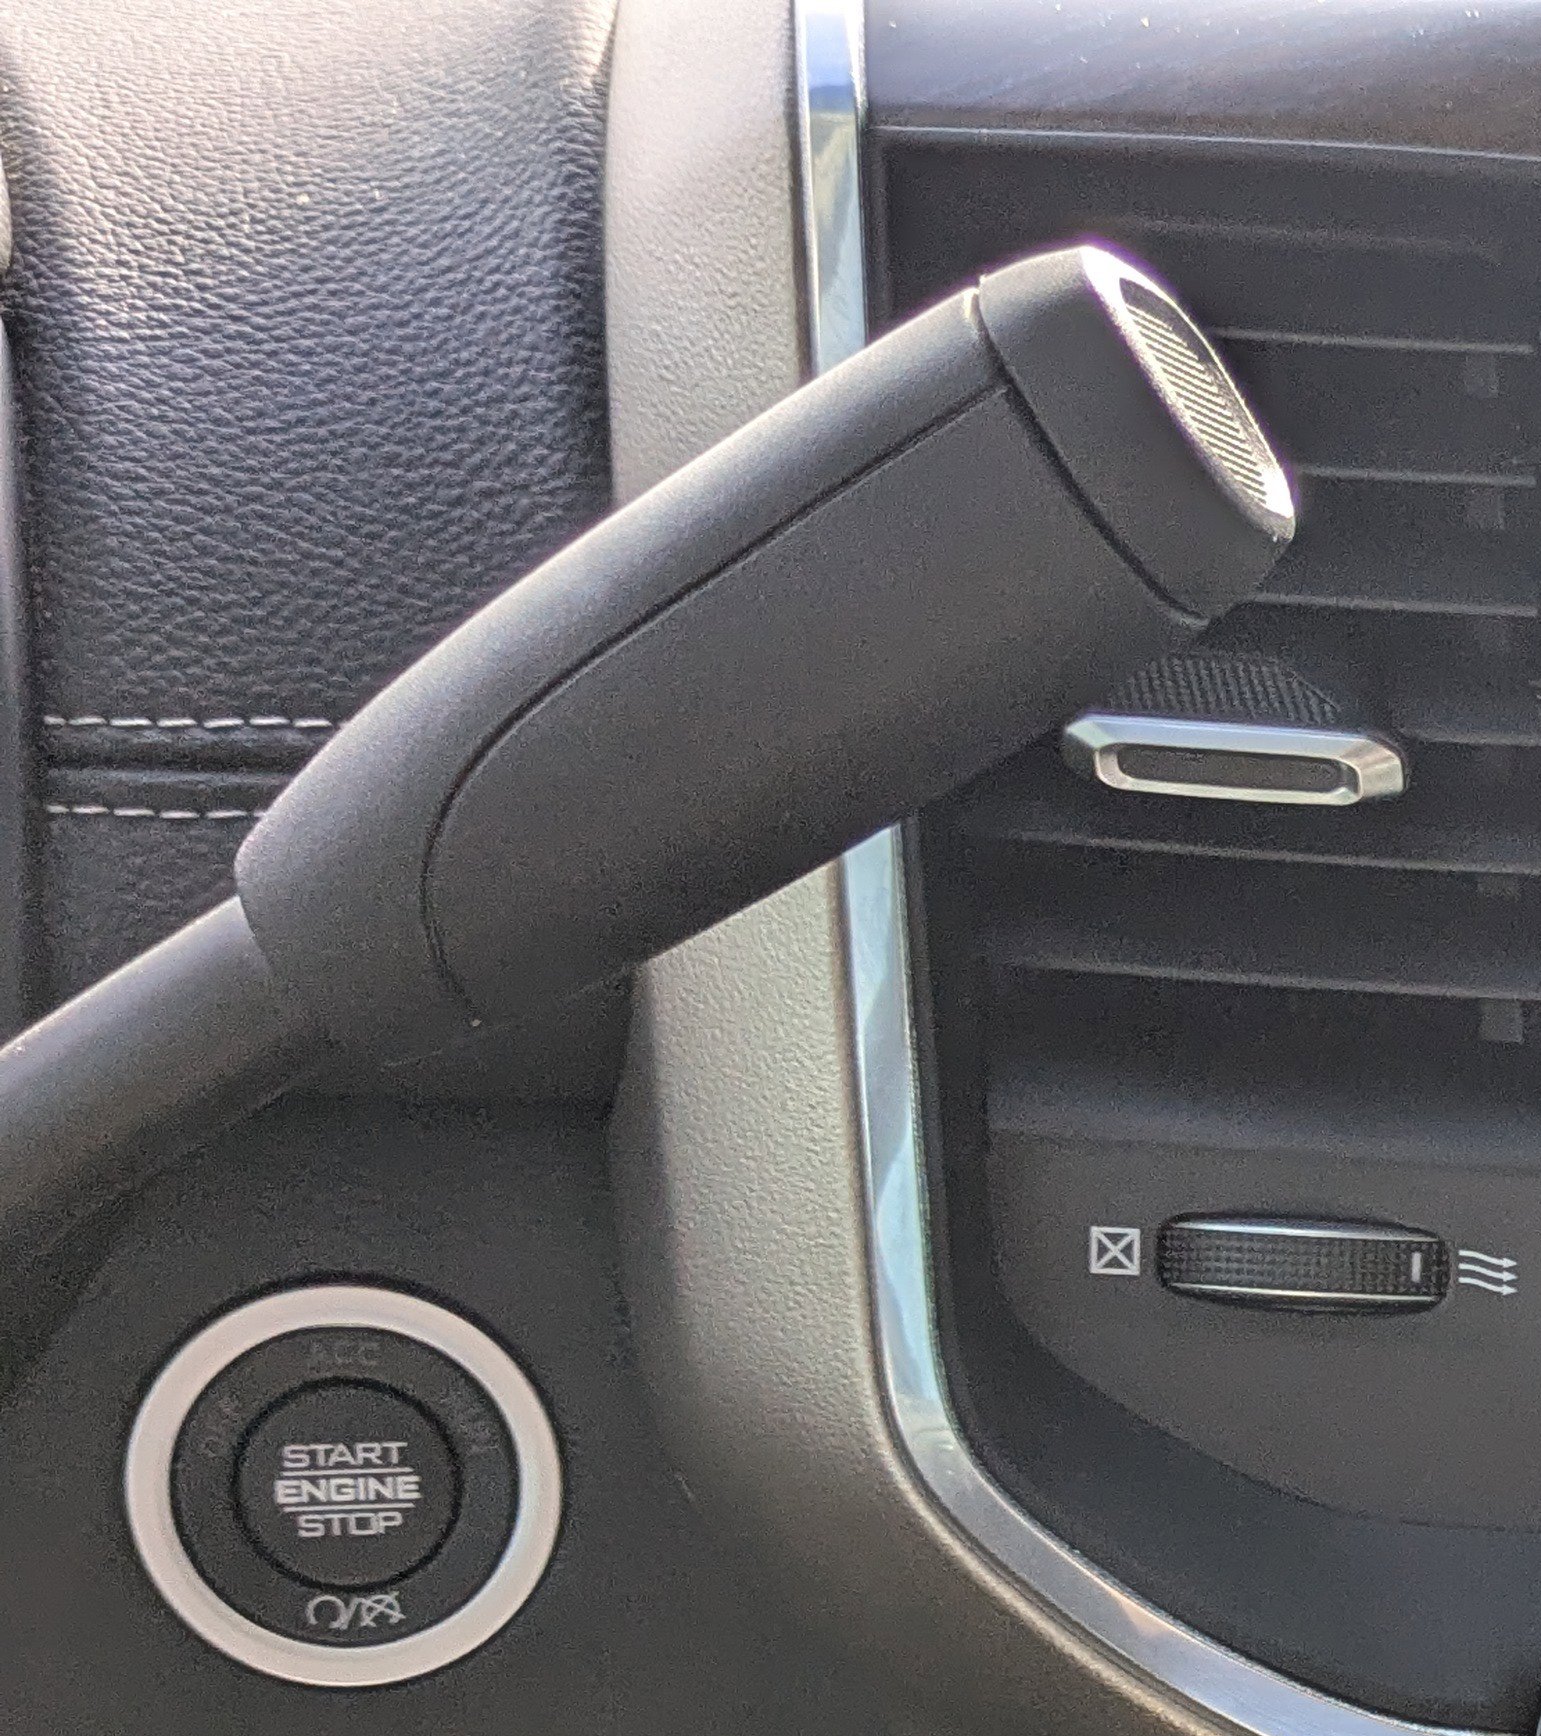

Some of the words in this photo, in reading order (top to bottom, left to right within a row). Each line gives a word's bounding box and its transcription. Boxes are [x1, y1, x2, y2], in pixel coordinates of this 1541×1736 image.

[282, 1442, 408, 1468] START
[275, 1475, 422, 1502] ENGINE
[299, 1512, 403, 1538] STOP
